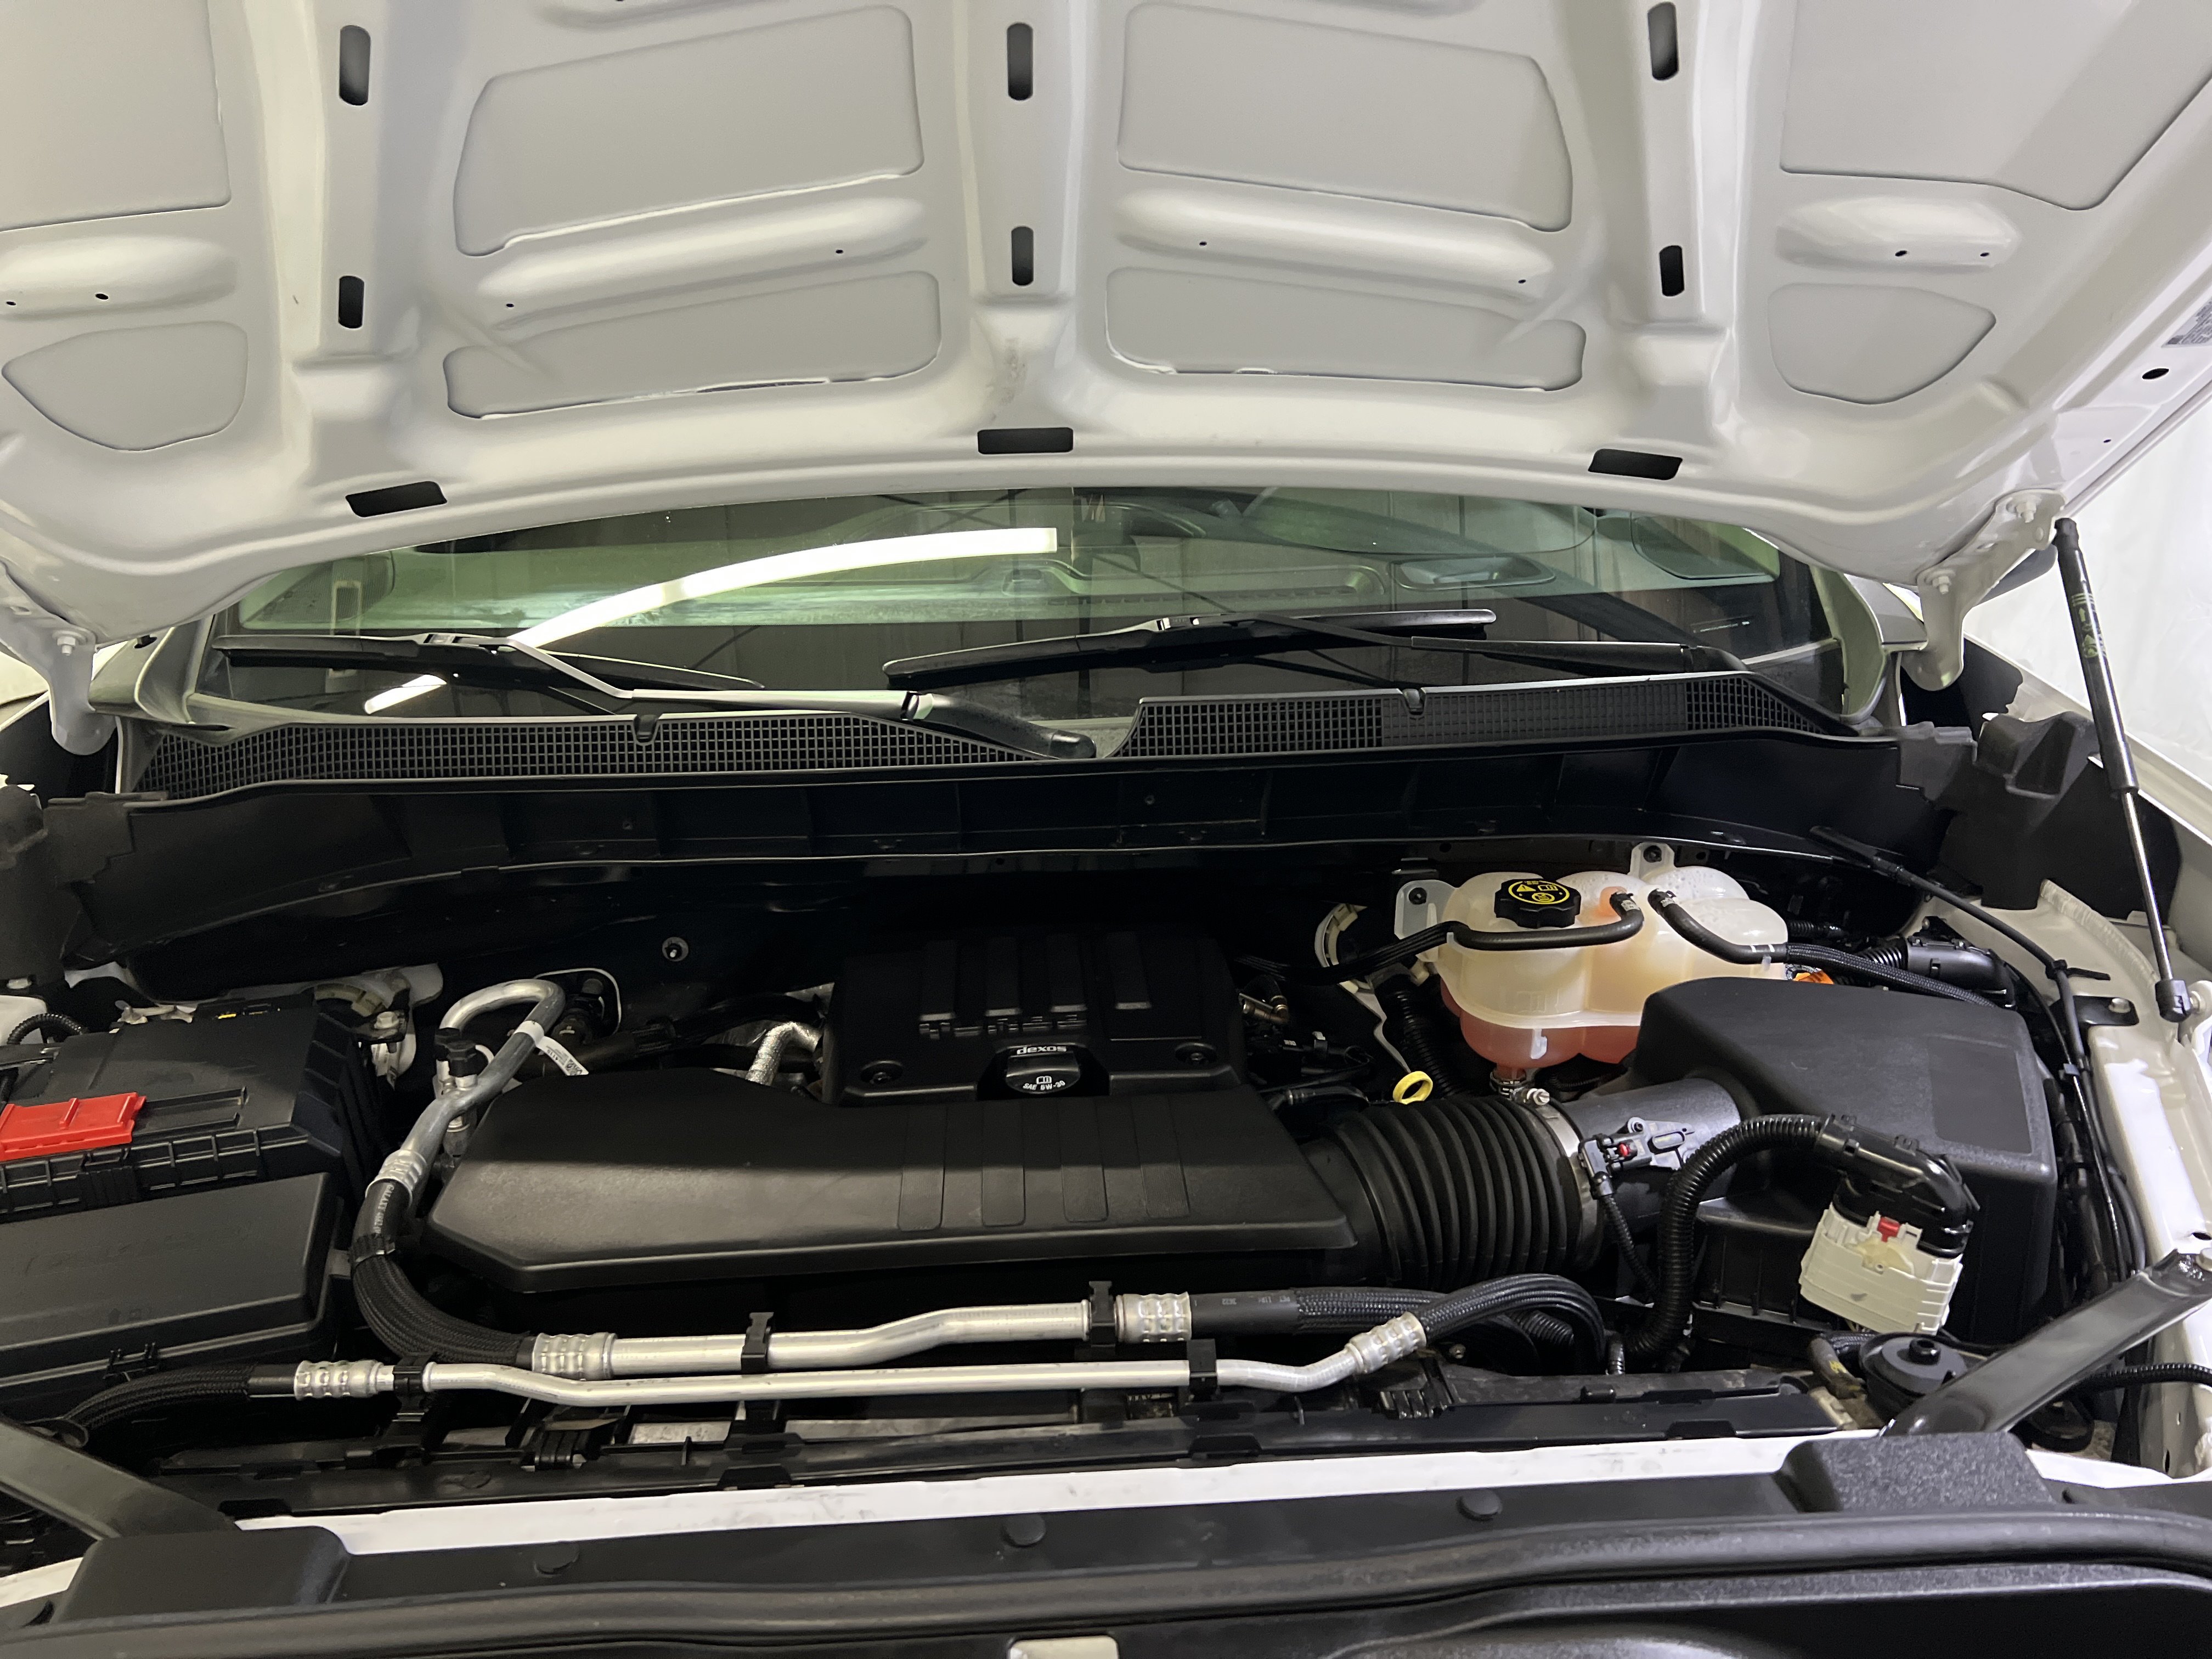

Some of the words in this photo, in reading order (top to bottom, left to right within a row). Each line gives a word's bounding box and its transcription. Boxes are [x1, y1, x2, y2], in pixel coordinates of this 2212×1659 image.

[1017, 1046, 1067, 1054] dexos
[1022, 1082, 1037, 1091] SAE
[1040, 1080, 1066, 1091] 5W-30
